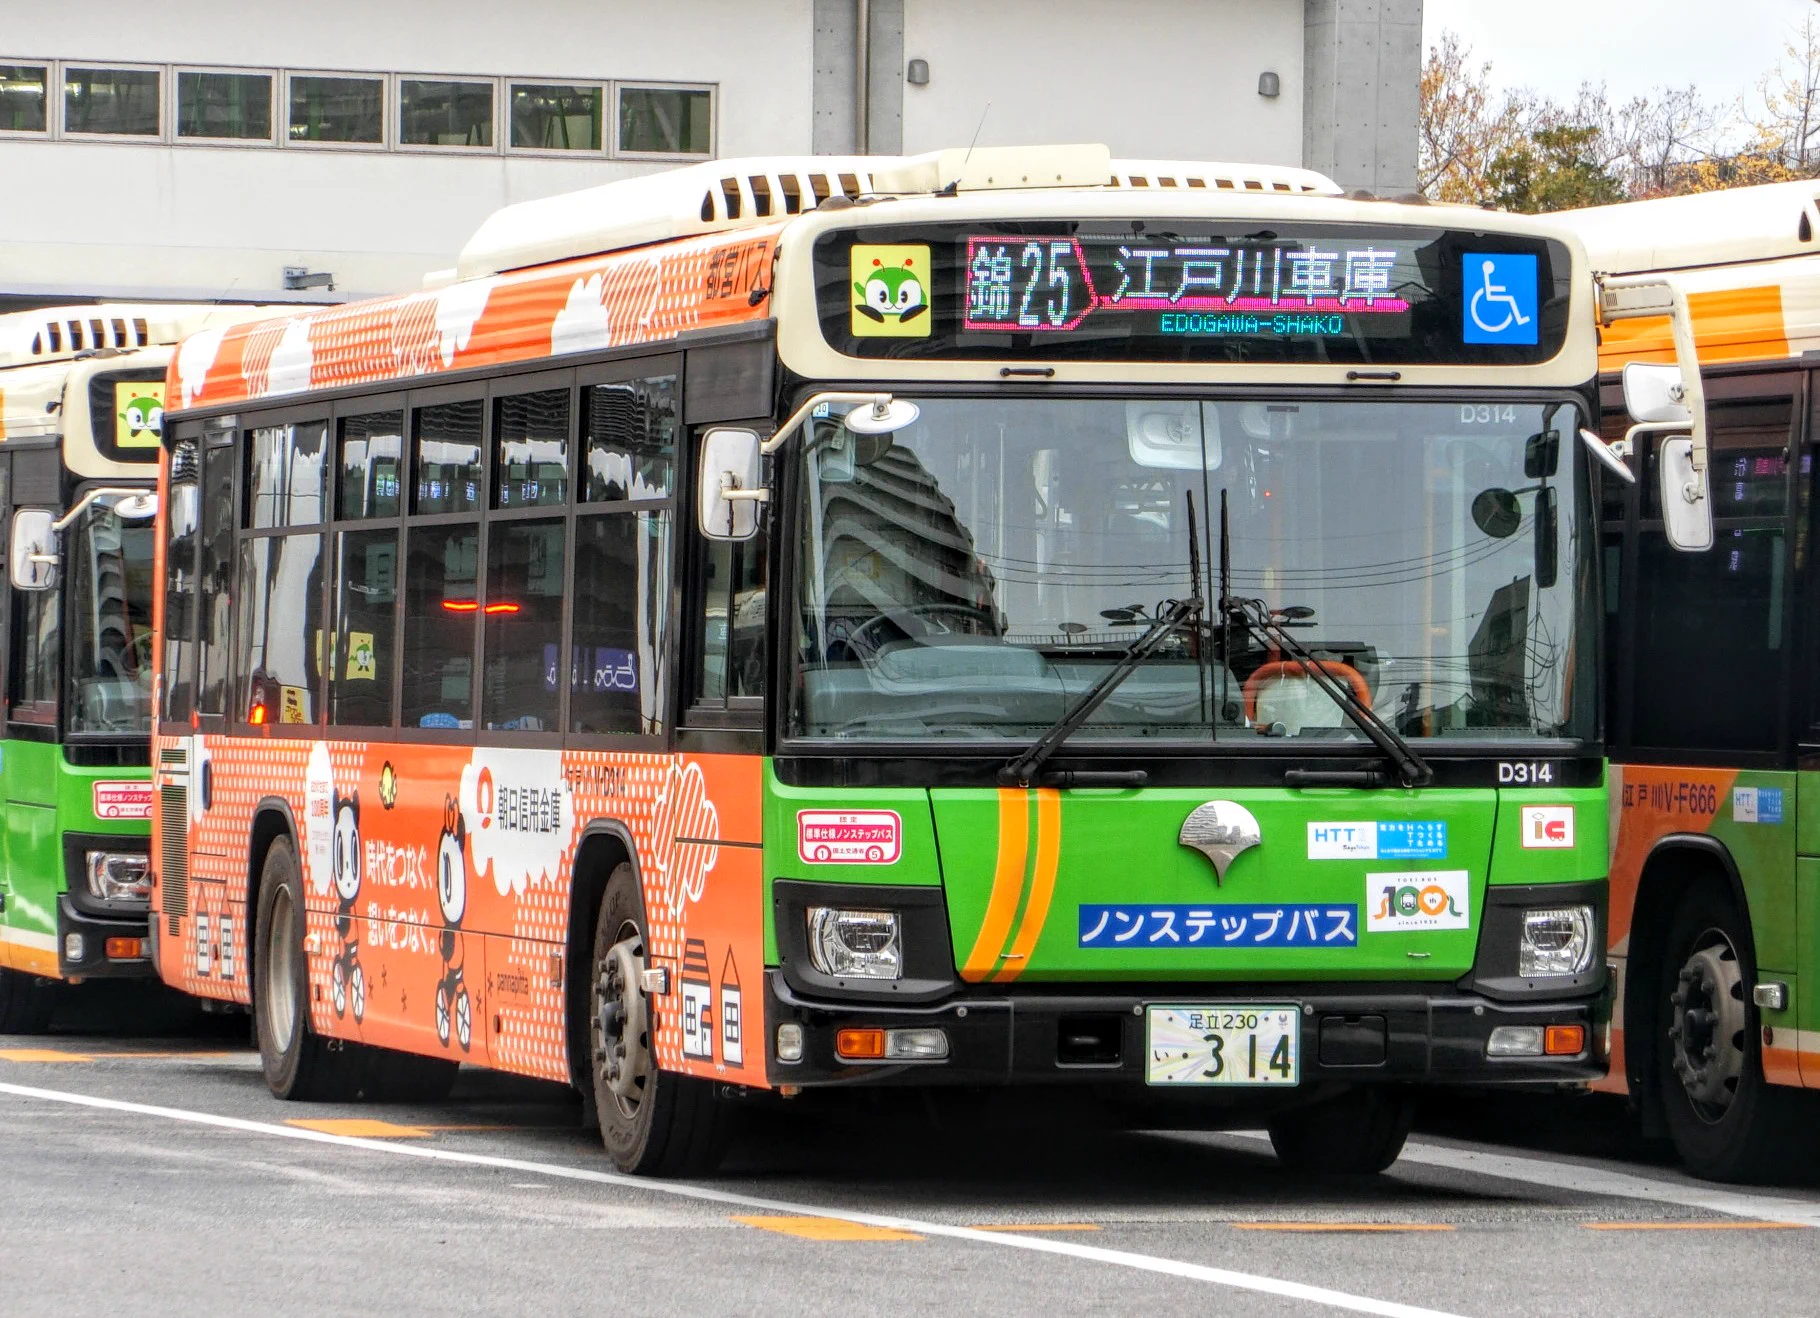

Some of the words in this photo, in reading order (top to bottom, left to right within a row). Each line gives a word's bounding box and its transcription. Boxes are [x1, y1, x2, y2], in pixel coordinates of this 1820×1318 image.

[706, 241, 768, 299] 都営バス
[1112, 246, 1397, 305] 江戸川車庫
[1161, 313, 1342, 333] EDOGAWA-SHAKO
[1460, 404, 1517, 423] D314
[1498, 763, 1553, 783] D314
[498, 784, 562, 835] 朝日信用金庫
[806, 828, 893, 840] 標準仕様ノンステップバス
[1315, 828, 1356, 842] HTT
[1081, 908, 1355, 942] ノンステップバス
[1154, 1050, 1169, 1062] い
[1202, 1034, 1291, 1078] 314
